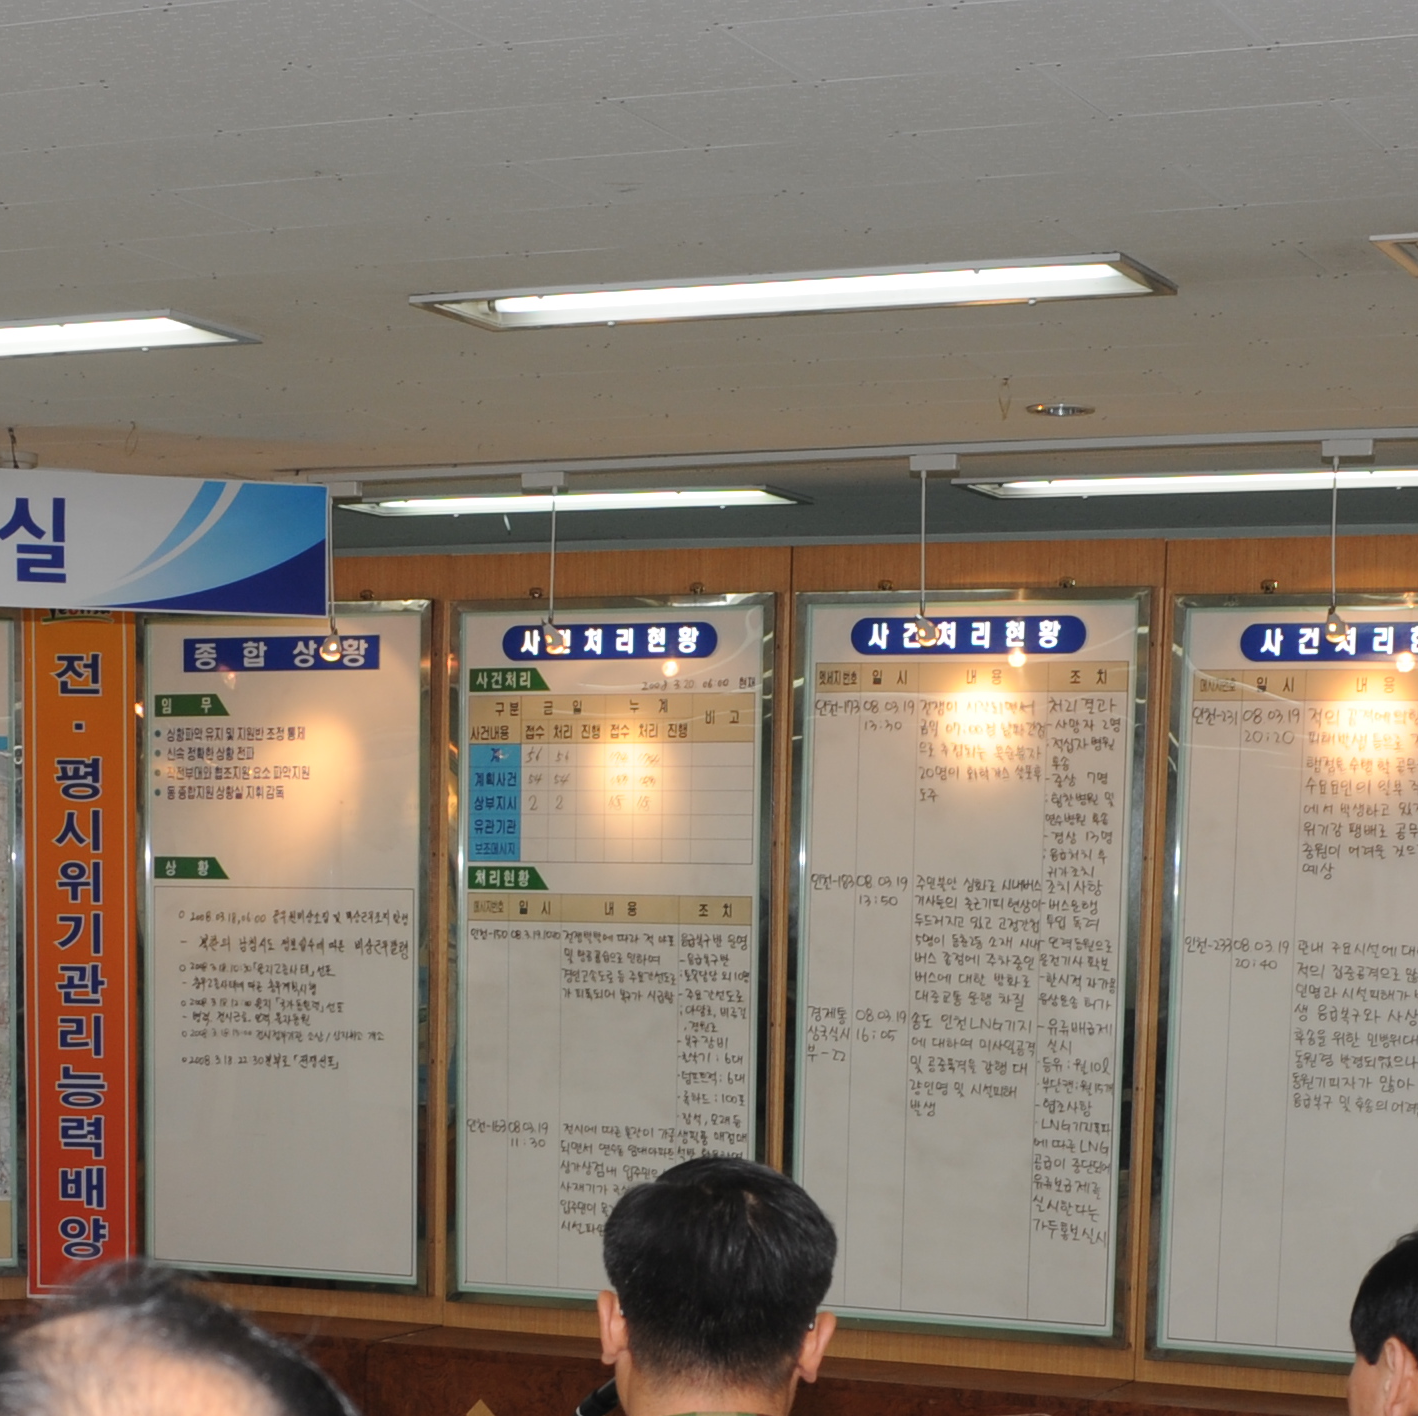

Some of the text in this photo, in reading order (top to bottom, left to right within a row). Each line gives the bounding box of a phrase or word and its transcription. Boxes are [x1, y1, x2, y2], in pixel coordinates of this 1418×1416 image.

[476, 670, 532, 689] 사건처리
[495, 701, 519, 717] 구분
[205, 728, 223, 741] 유지
[470, 725, 510, 740] 사건내용
[525, 725, 545, 740] 접수
[554, 724, 573, 740] 처리
[581, 724, 601, 740] 진행
[610, 724, 630, 740] 접수
[638, 723, 659, 739] 처리
[667, 722, 688, 739] 진행
[253, 767, 270, 780] 요소
[474, 772, 517, 788] 계획사건
[474, 795, 517, 811] 상부지시
[474, 819, 516, 835] 유관기관
[475, 868, 530, 887] 처리현황
